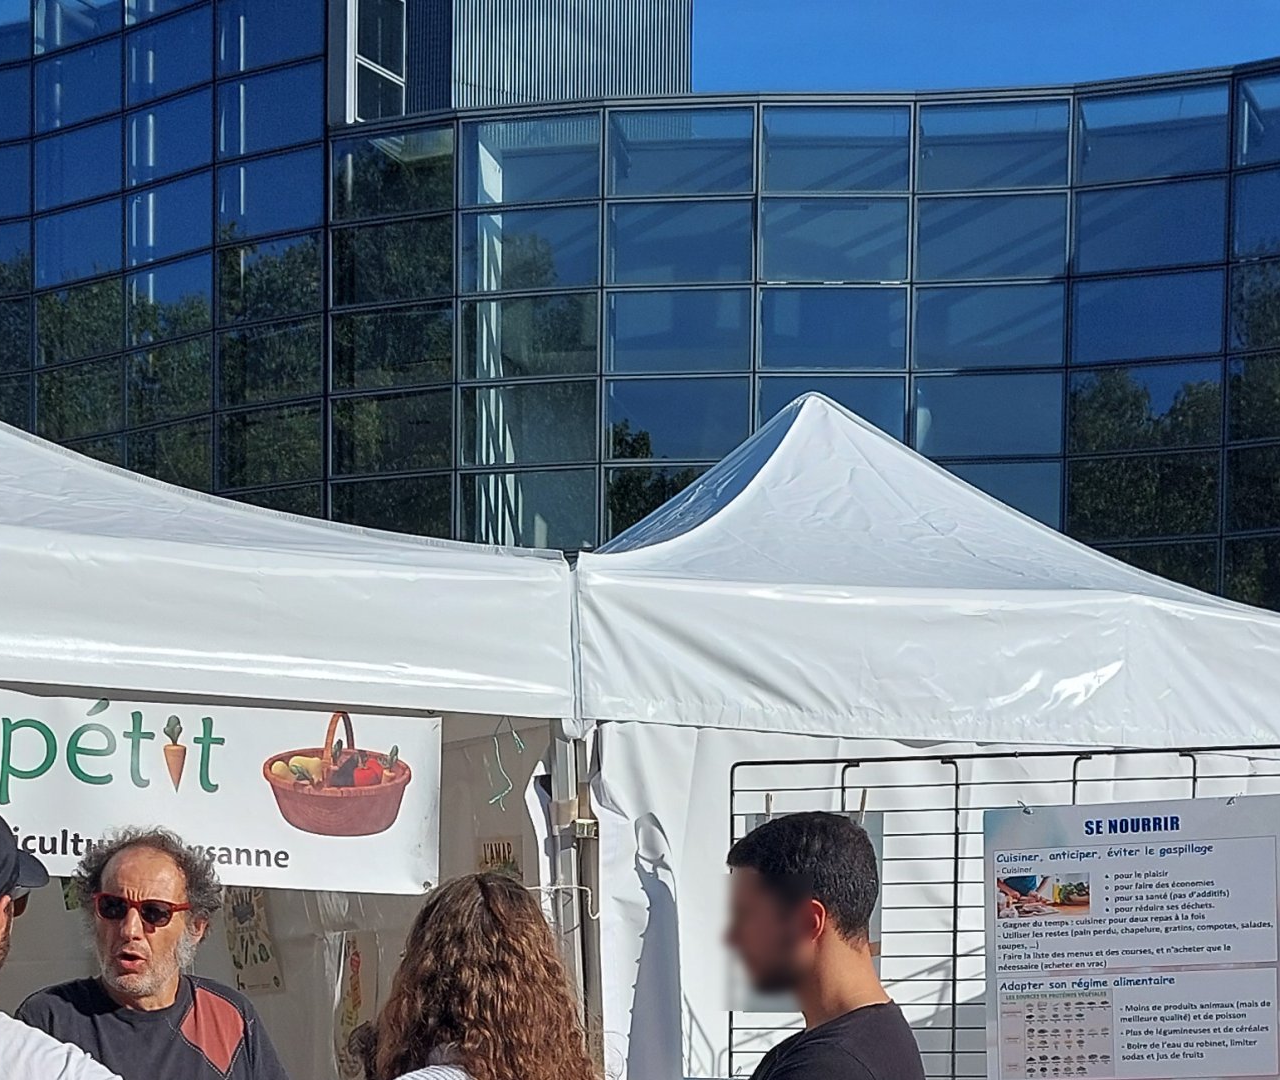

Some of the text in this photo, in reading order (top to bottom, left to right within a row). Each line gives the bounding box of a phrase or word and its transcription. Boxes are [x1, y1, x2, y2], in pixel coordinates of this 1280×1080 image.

[1085, 816, 1180, 835] SE NOURRIR
[997, 844, 1213, 863] Cuisiner, anticiper, éviter le gaspillage
[1144, 870, 1168, 879] plaisir
[1170, 893, 1186, 901] (pas
[1189, 890, 1230, 898] d'additifs)
[1135, 904, 1164, 912] réduire
[1000, 982, 1044, 993] Adapter
[1072, 978, 1108, 990] régime
[1113, 976, 1175, 987] alimentaire
[1164, 1003, 1197, 1012] produits
[1237, 1000, 1258, 1009] (mais
[1160, 1014, 1190, 1022] qualité)
[1216, 1013, 1246, 1021] poisson
[1156, 1027, 1210, 1036] légumineuses
[1127, 1042, 1147, 1050] Boire
[1162, 1040, 1181, 1048] l'eau
[1156, 1052, 1168, 1061] jus
